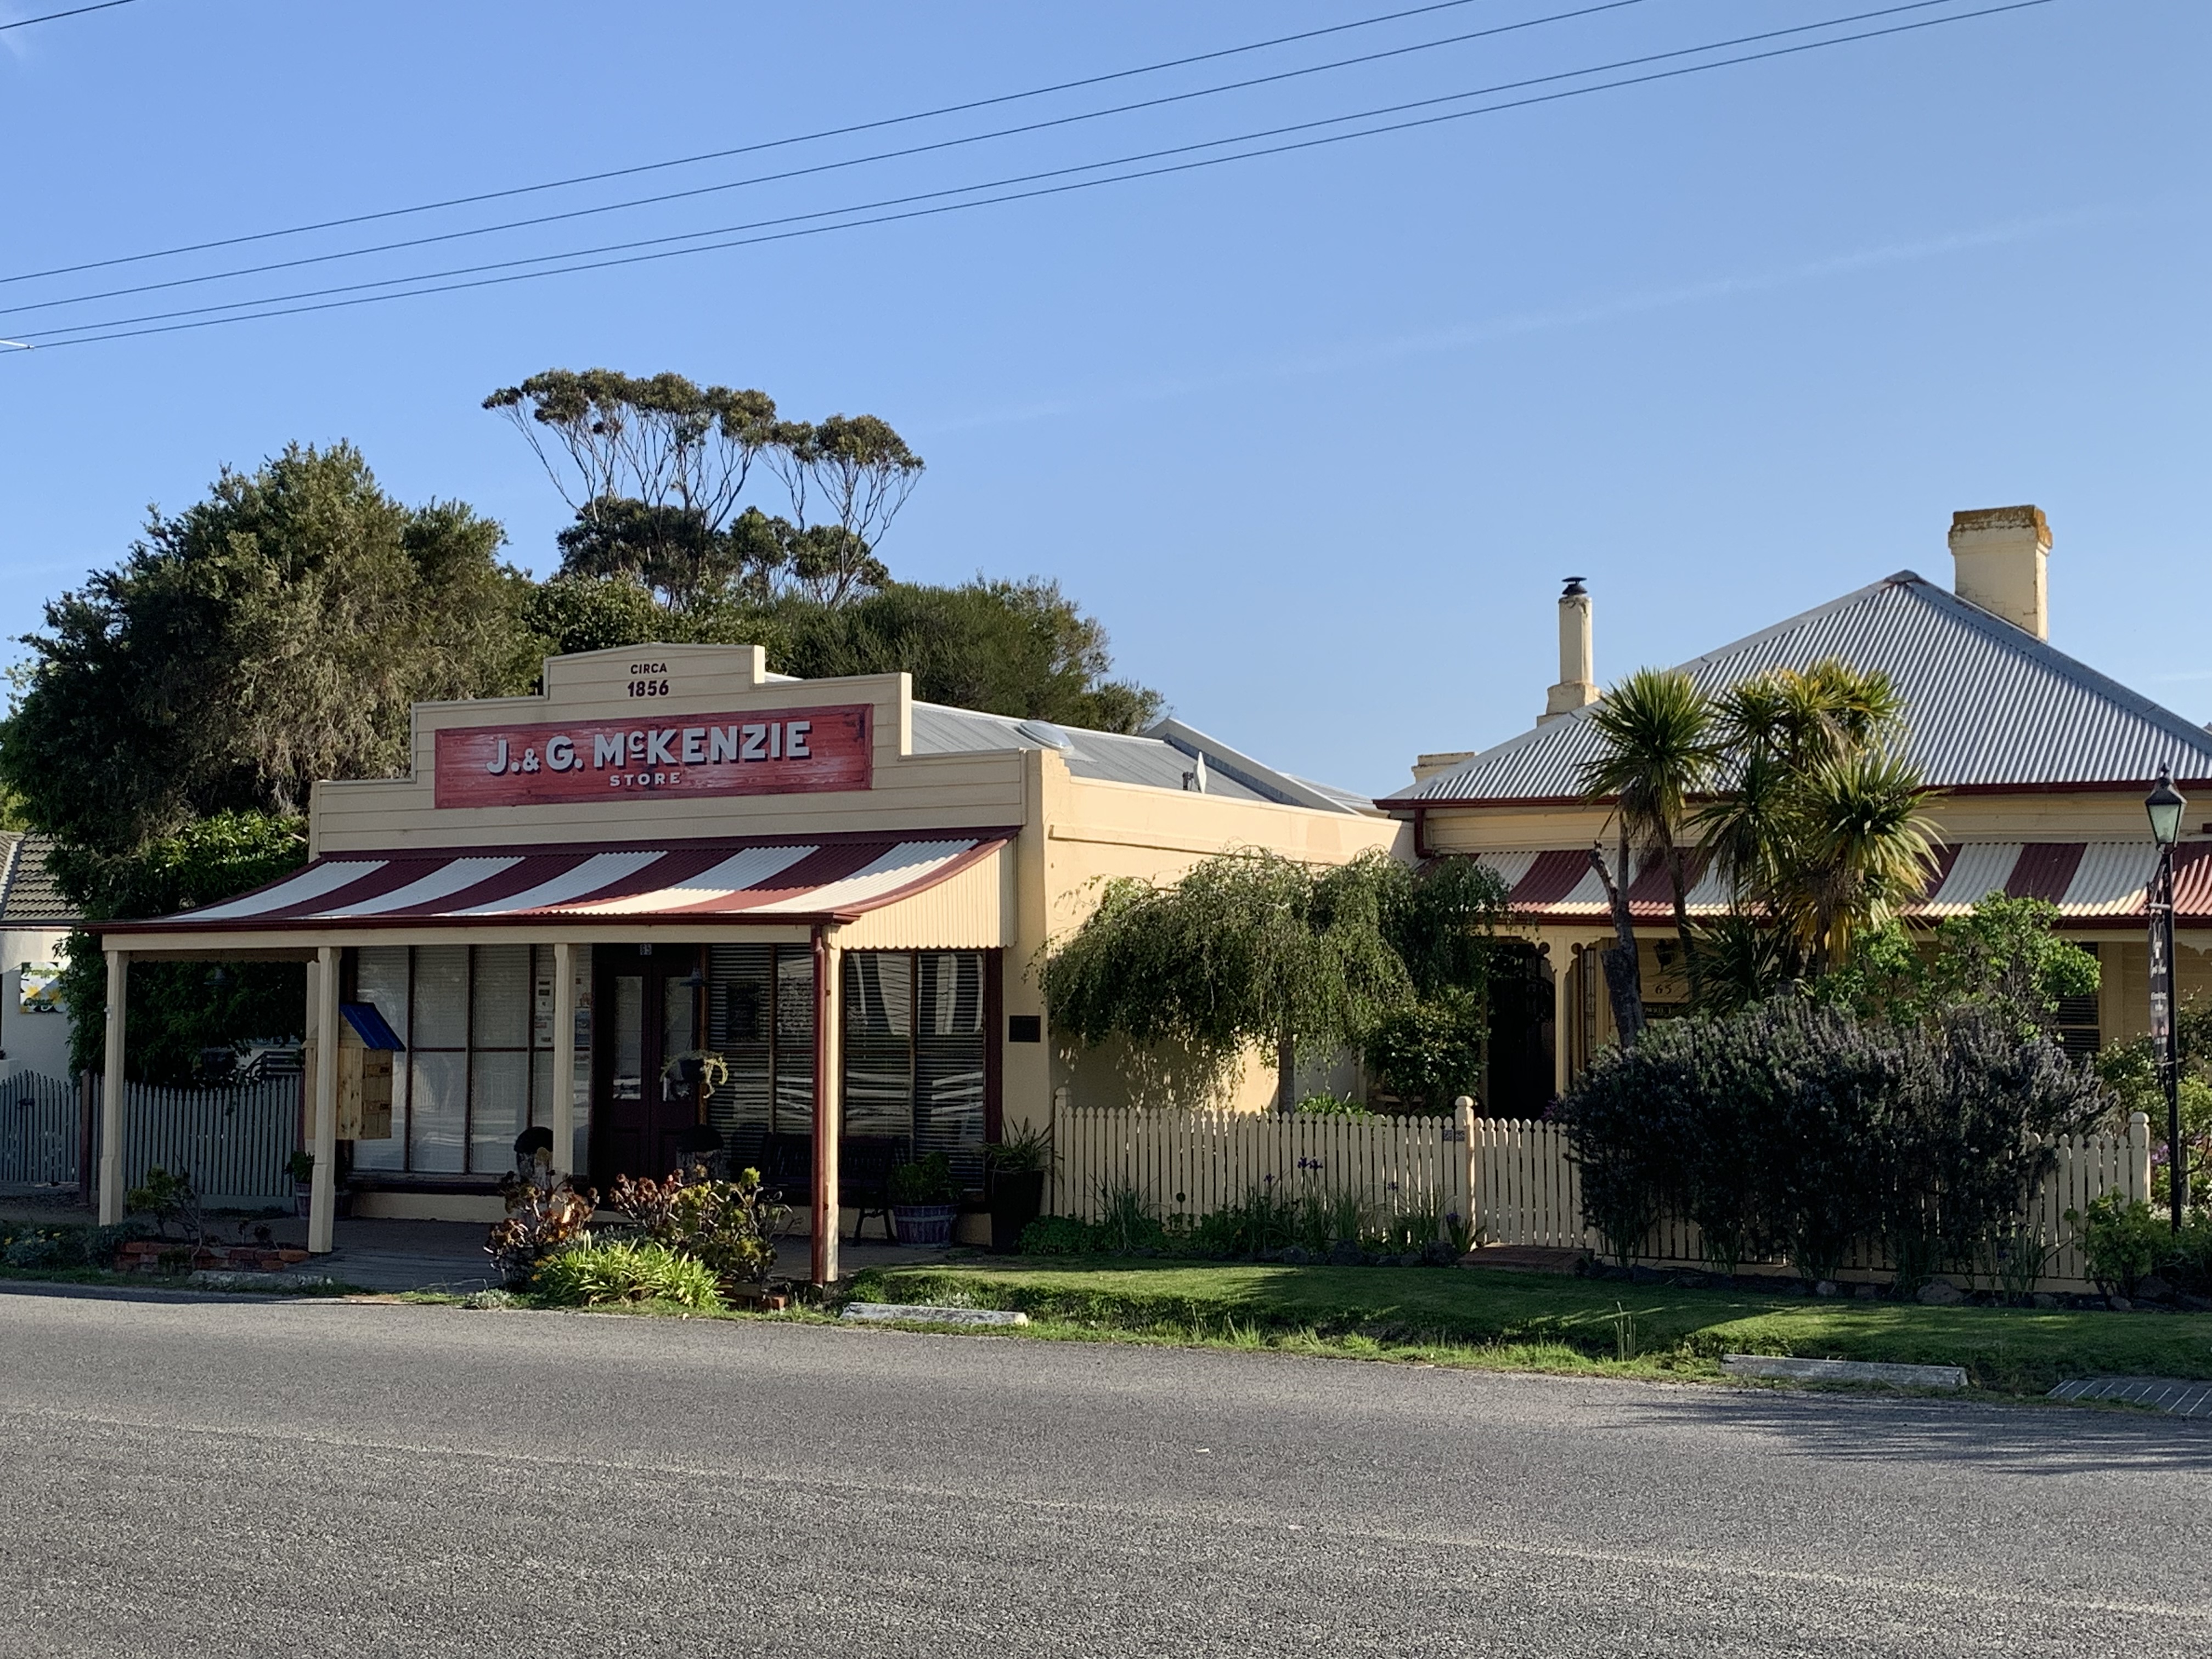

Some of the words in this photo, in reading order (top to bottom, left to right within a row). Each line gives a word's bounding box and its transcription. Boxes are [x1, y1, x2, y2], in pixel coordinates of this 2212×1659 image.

[630, 663, 667, 674] CIRCA
[628, 680, 669, 697] 1856
[610, 772, 681, 787] STORE
[1655, 983, 1672, 995] 65
